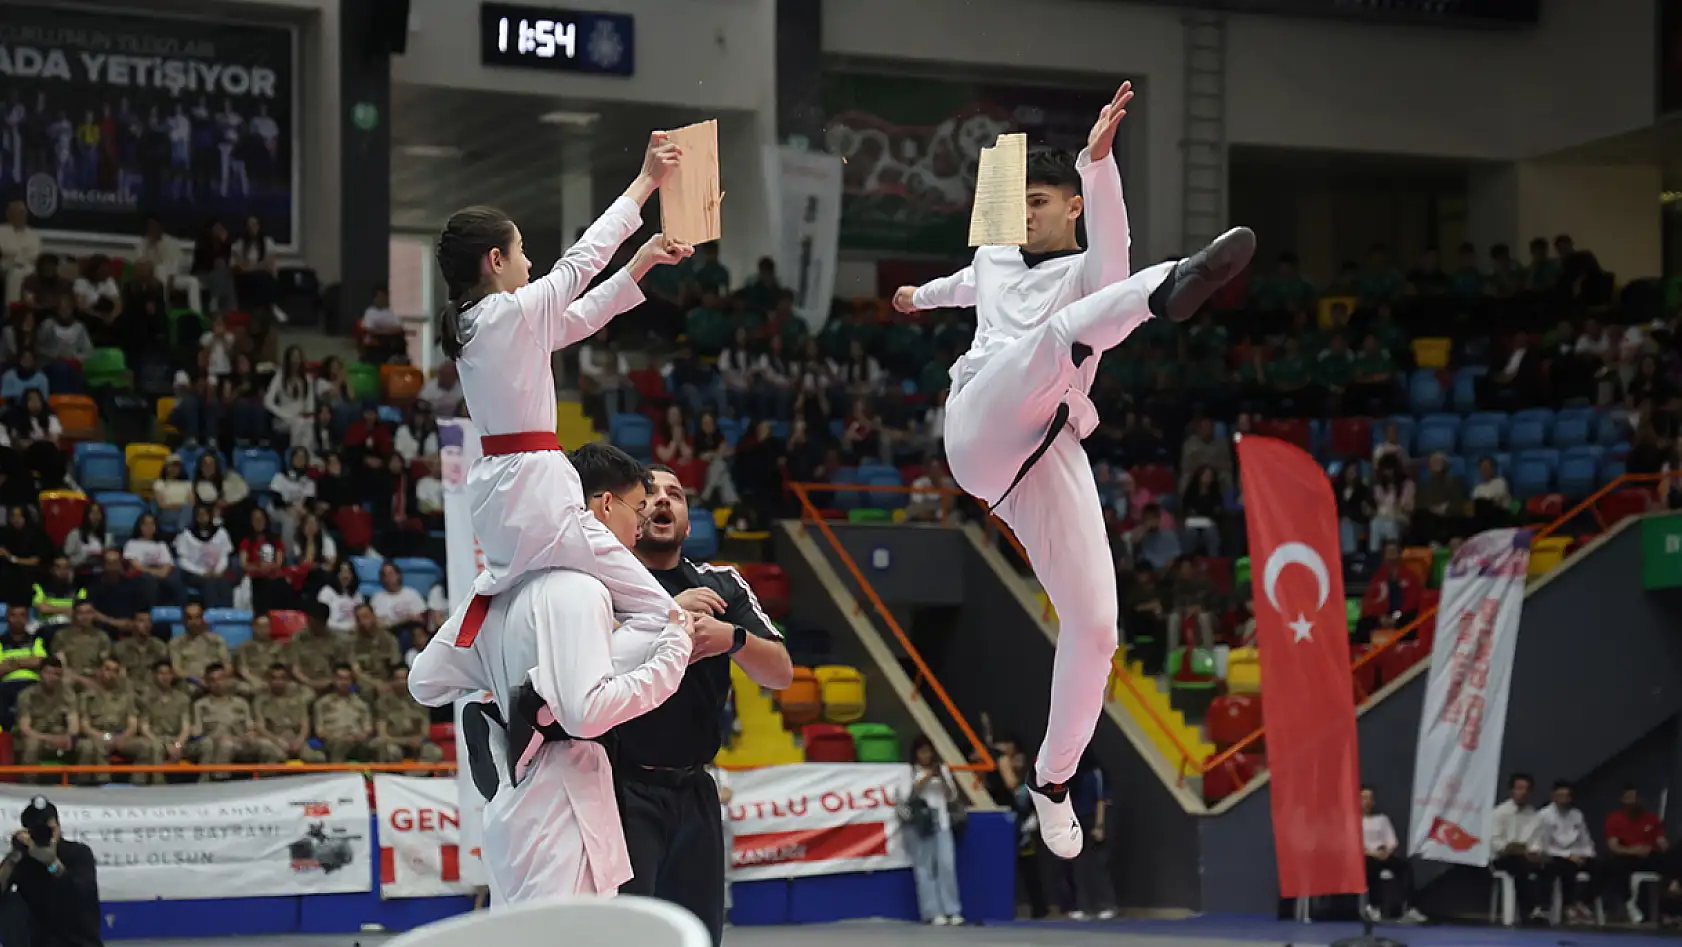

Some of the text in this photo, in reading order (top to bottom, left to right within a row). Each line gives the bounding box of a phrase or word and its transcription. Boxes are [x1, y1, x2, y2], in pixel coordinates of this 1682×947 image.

[498, 17, 576, 58] 11:54
[728, 796, 808, 821] UTLU
[146, 850, 214, 866] OLSUN
